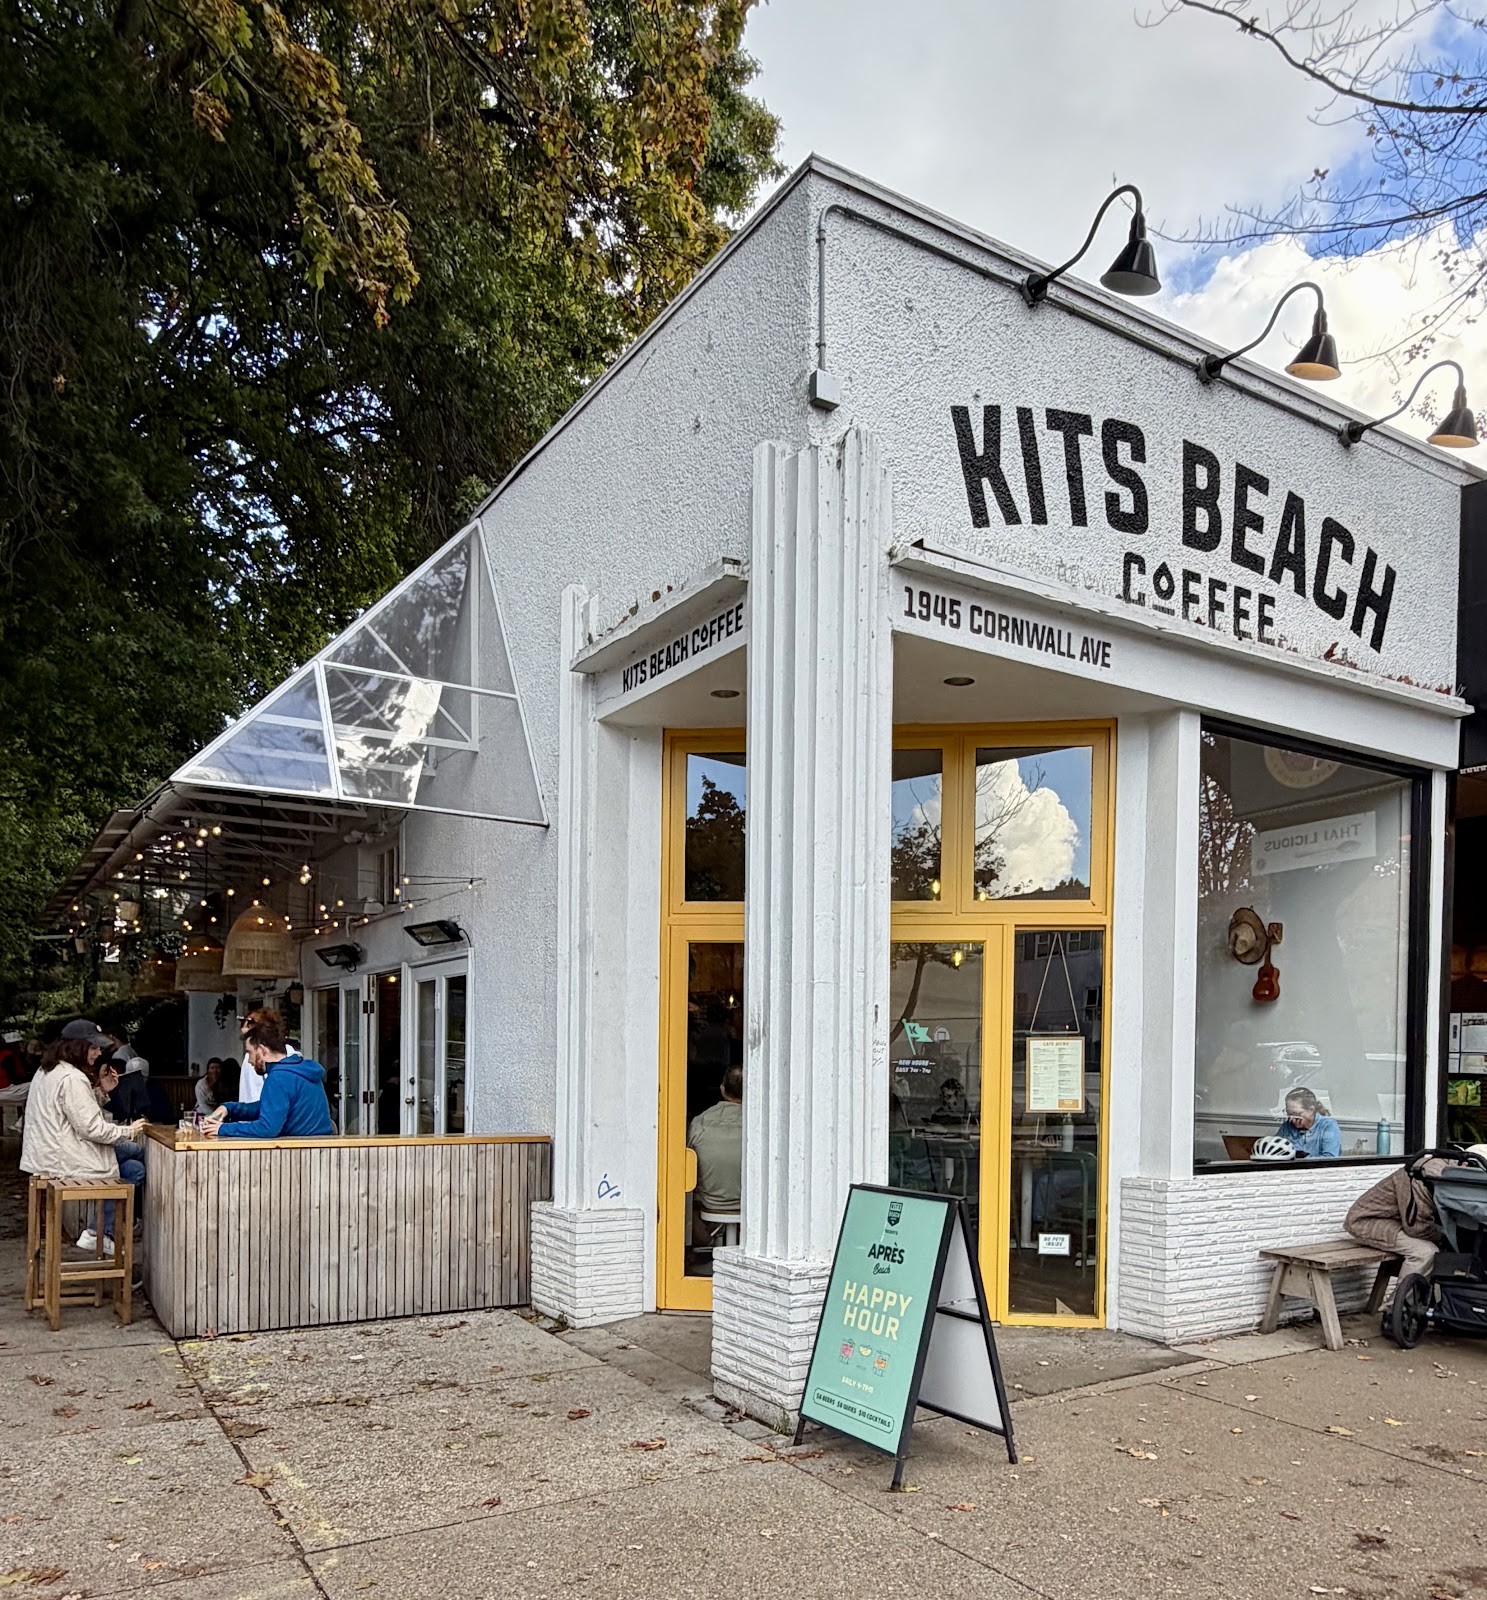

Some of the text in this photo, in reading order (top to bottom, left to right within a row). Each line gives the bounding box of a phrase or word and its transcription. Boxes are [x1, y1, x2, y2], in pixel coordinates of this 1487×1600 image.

[950, 405, 1397, 653] KITS BEACH
[1121, 551, 1276, 644] COFFEE
[904, 586, 1112, 669] 1945 CORNWALL AVE
[622, 602, 744, 694] KITS BEACH COFFEE
[908, 1025, 918, 1035] K
[867, 1242, 906, 1265] APRÈS
[872, 1262, 891, 1275] Beach
[842, 1279, 913, 1317] HAPPY
[843, 1304, 900, 1341] HOUR
[866, 1413, 891, 1428] COCKTAILS
